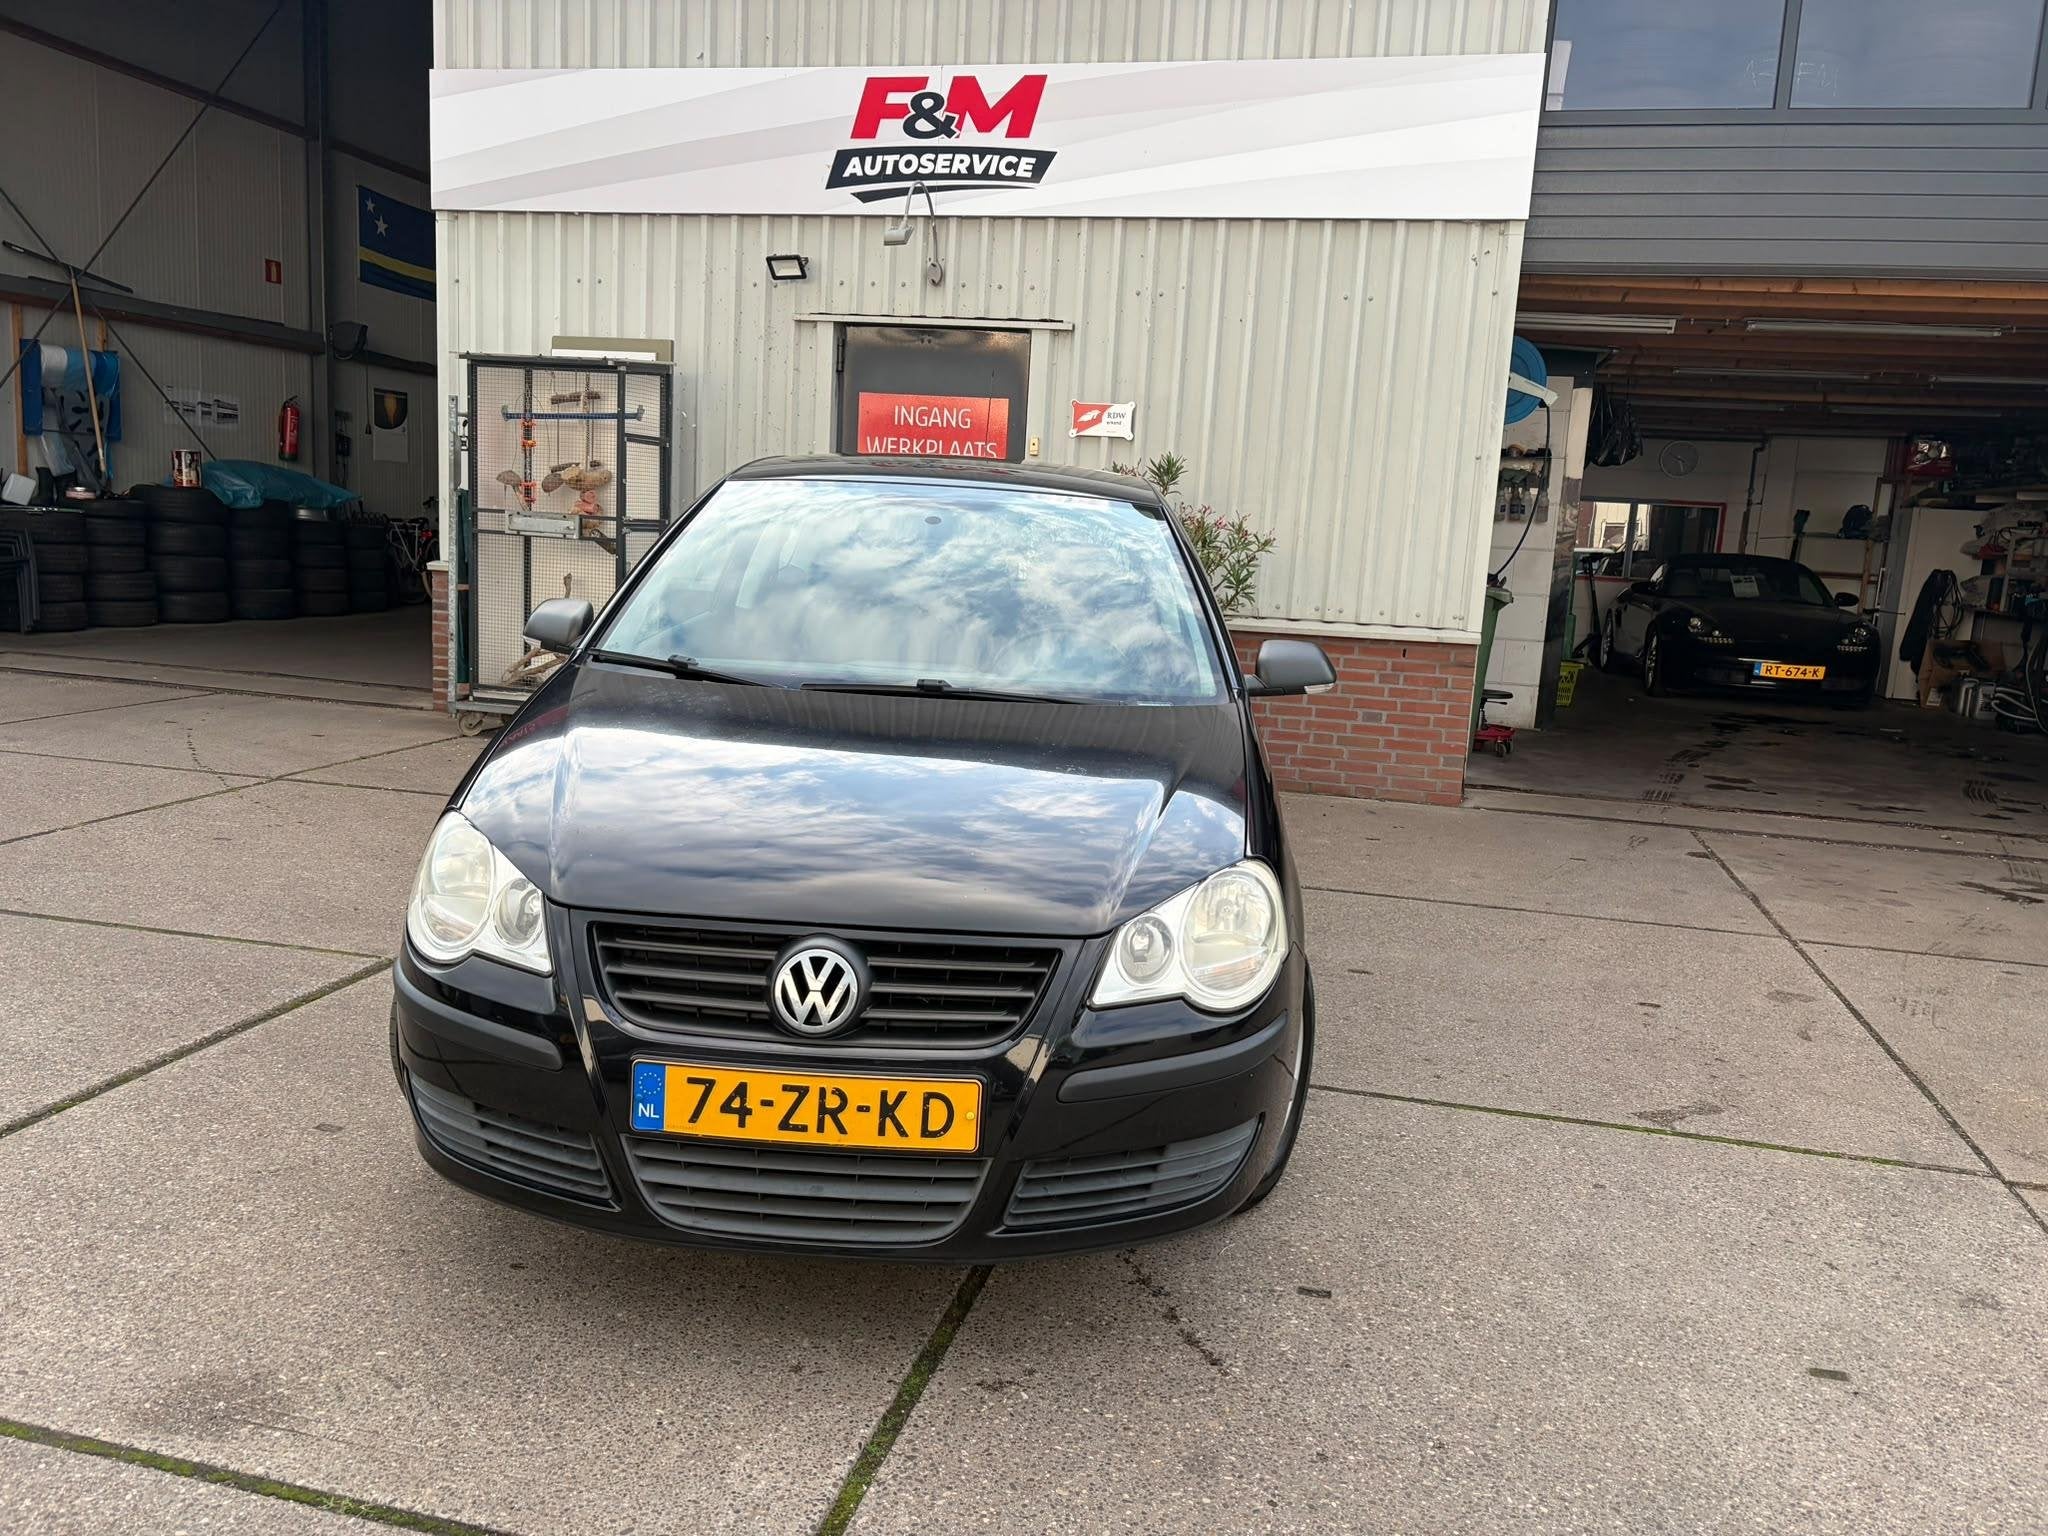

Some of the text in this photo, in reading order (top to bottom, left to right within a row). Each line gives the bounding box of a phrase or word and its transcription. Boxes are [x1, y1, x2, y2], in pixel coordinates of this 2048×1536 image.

[851, 74, 1048, 139] F&M
[842, 153, 1037, 178] AUTOSERVICE
[894, 405, 972, 429] INGANG
[1107, 411, 1126, 419] RDW
[866, 436, 997, 459] WERKPLAATS
[1765, 665, 1820, 678] RT-674-K
[638, 1102, 660, 1119] NL
[686, 1076, 955, 1139] 74-ZR-KD
